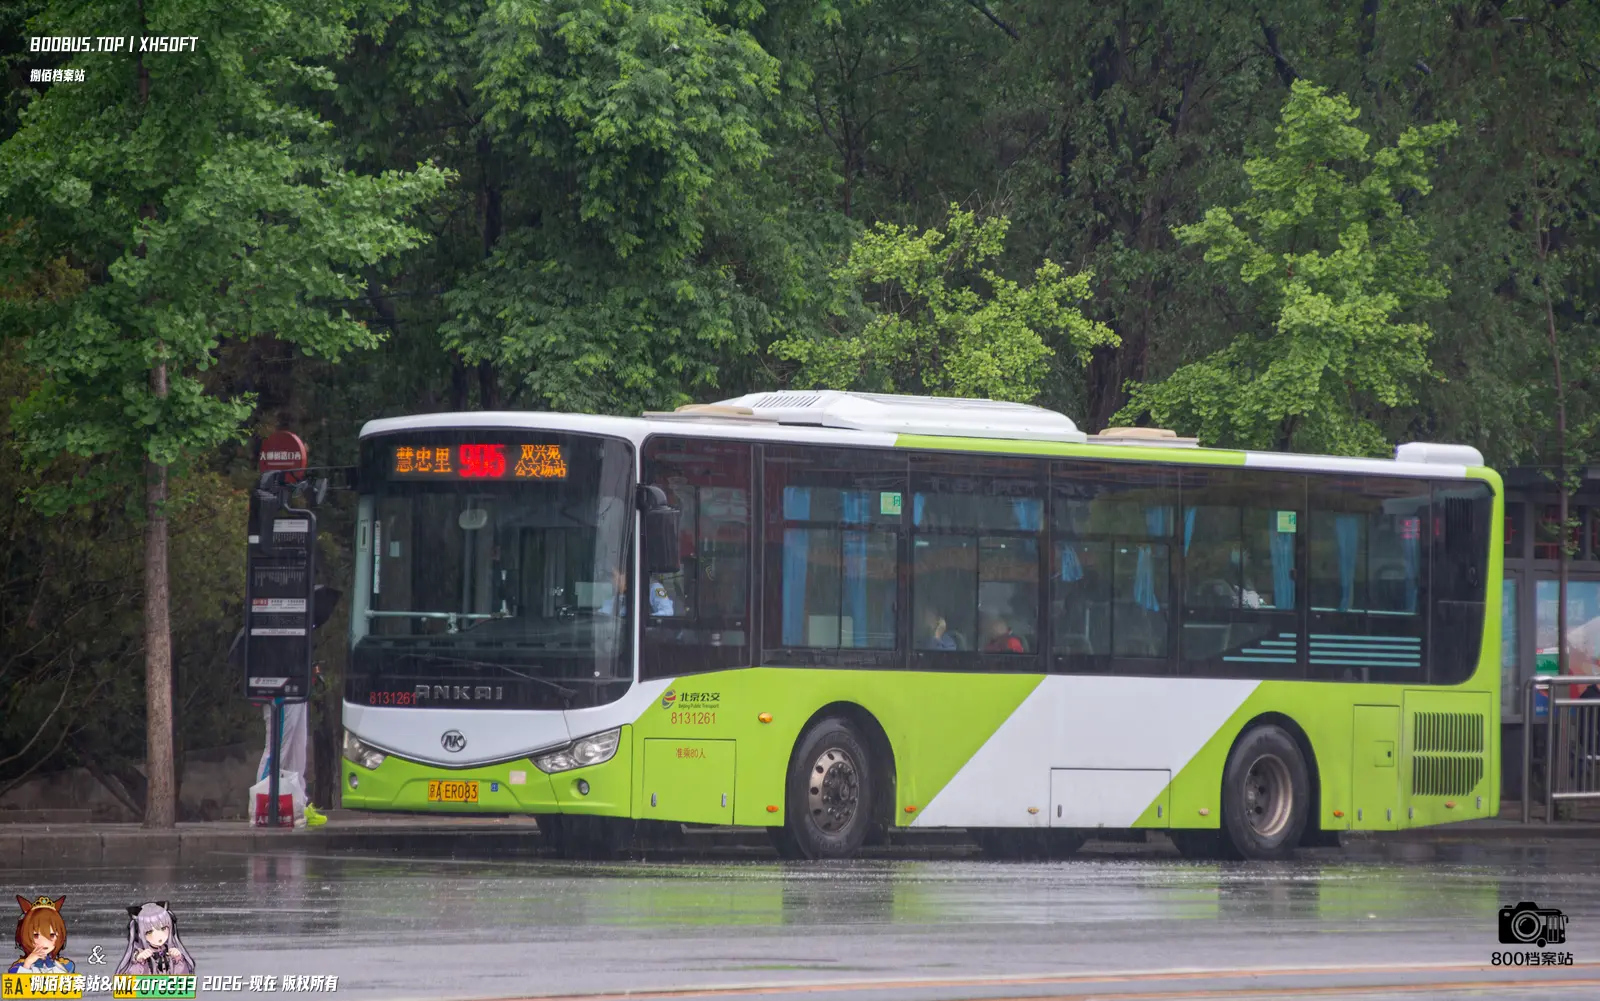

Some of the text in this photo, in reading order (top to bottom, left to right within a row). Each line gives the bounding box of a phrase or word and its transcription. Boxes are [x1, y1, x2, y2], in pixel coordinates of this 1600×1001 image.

[396, 447, 452, 473] 慧忠里
[514, 459, 567, 478] 公交场站
[369, 691, 417, 705] 8131261
[415, 684, 503, 700] ANKAI
[680, 692, 721, 702] 北京公交
[671, 711, 717, 725] 8131261
[676, 747, 707, 759] 准乘80人
